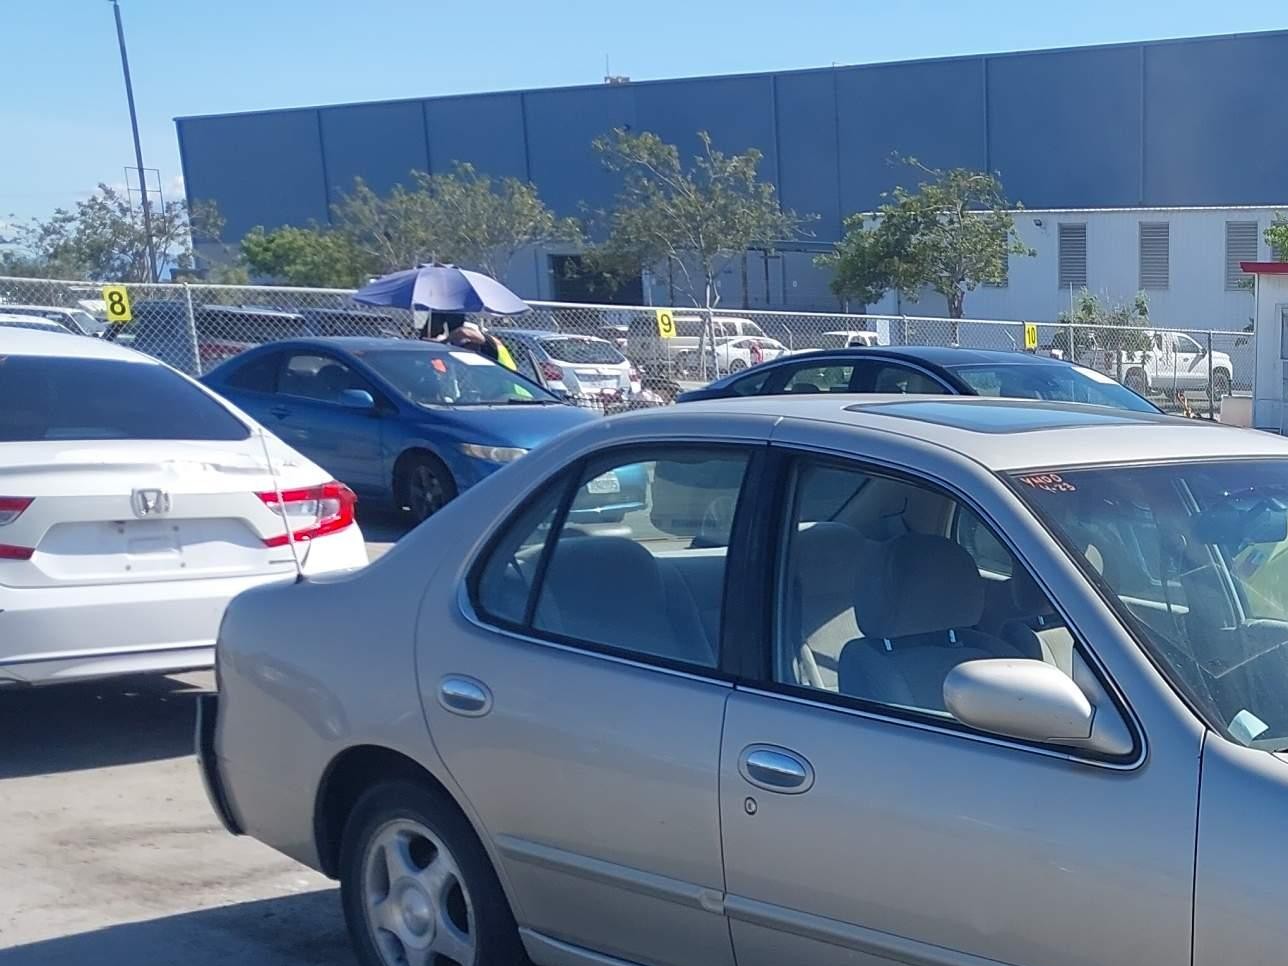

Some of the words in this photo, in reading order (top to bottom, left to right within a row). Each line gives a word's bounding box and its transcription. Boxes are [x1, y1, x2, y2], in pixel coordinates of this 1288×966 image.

[108, 290, 126, 316] 8
[660, 313, 672, 333] 9
[1027, 326, 1036, 345] 10
